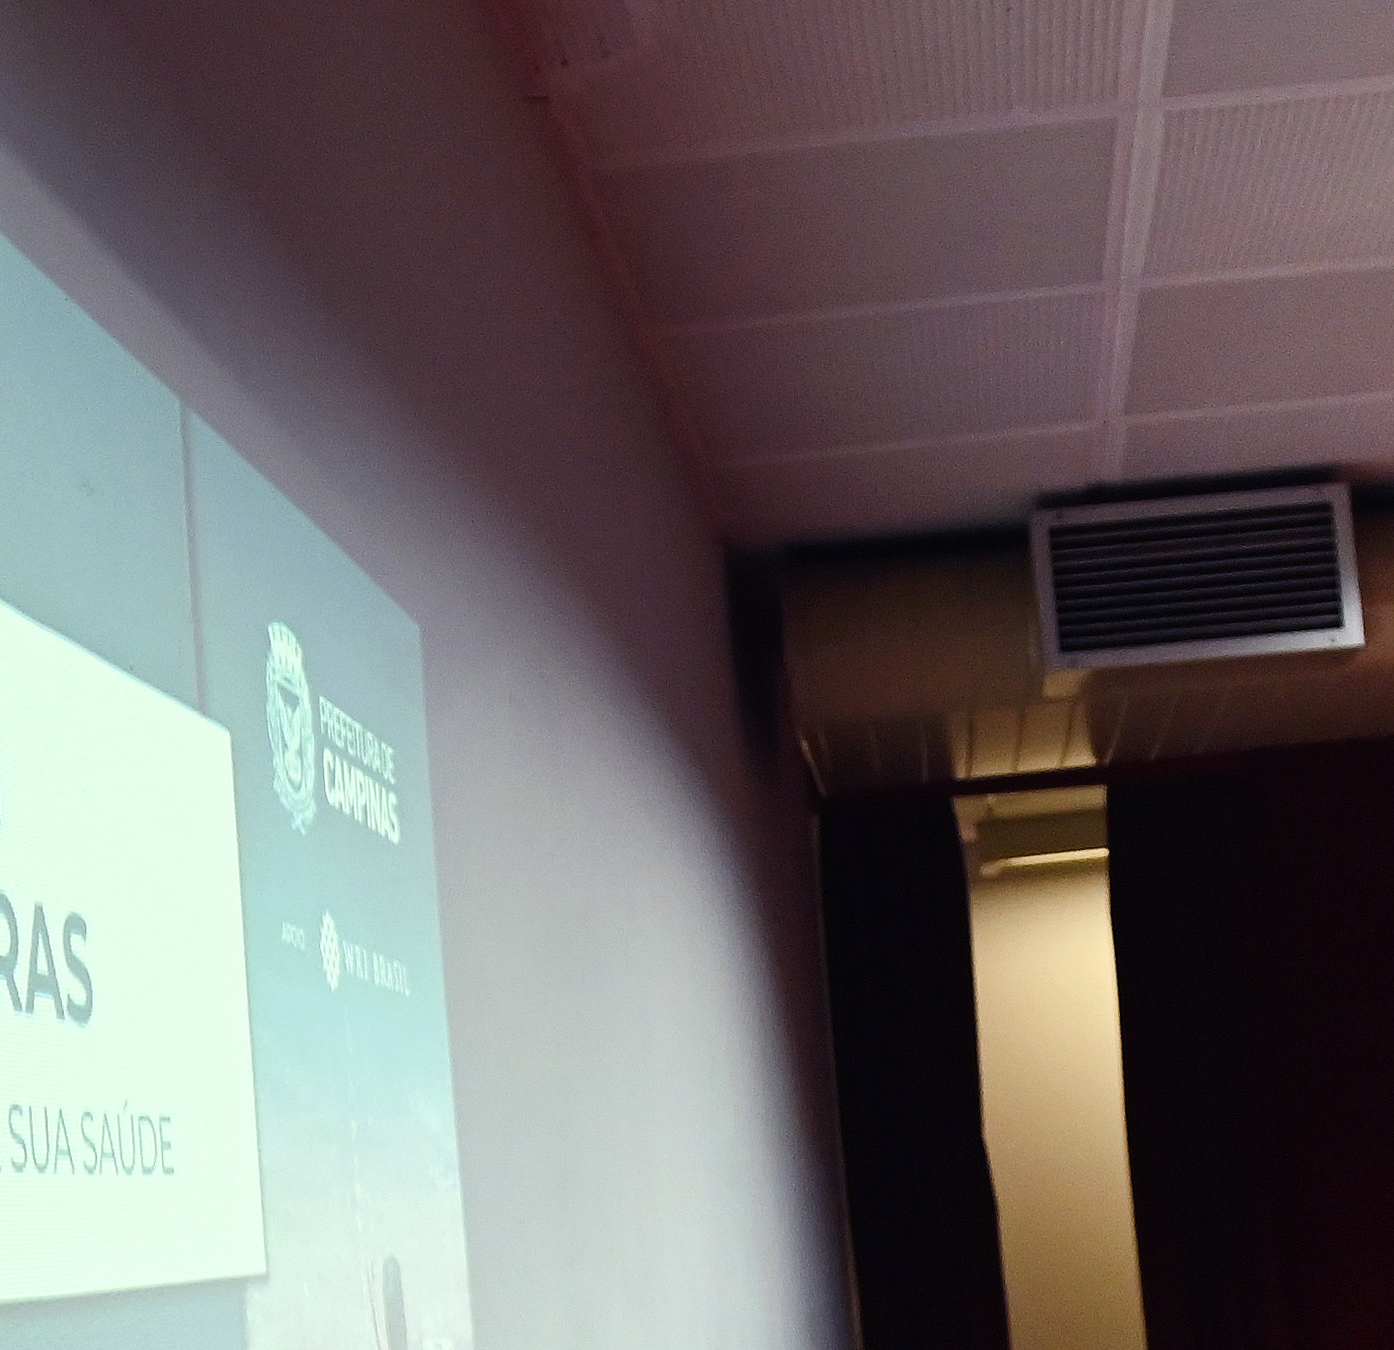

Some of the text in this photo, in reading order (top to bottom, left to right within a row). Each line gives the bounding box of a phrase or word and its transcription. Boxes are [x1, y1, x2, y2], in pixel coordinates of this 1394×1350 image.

[319, 695, 379, 772] PREFEITURA
[323, 746, 401, 845] CAMPINAS
[342, 940, 411, 997] WRI BRASIL
[8, 1104, 75, 1174] SUA
[80, 1101, 176, 1177] SAÚDE
